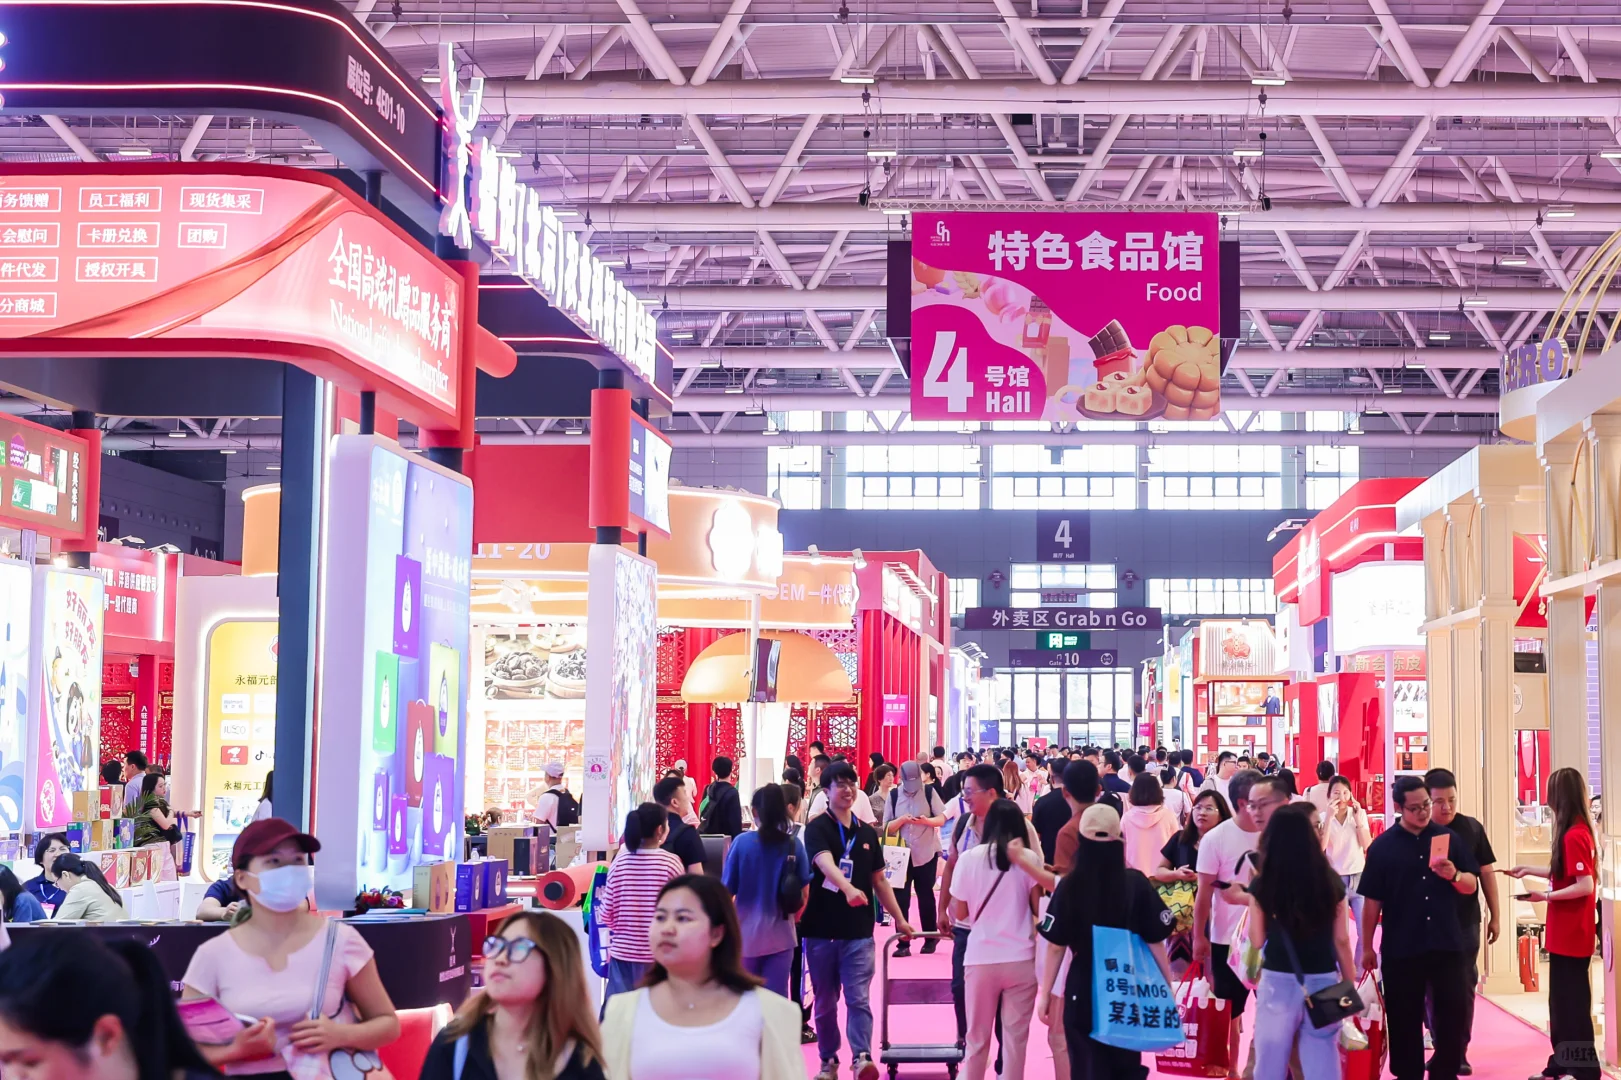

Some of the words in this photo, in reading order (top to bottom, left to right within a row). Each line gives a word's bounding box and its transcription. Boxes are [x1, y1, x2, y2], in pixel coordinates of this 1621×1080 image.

[0, 194, 49, 208] 务馈赠
[89, 193, 149, 208] 员工福利
[189, 192, 251, 209] 现货集采
[0, 229, 48, 243] 会慰问
[87, 228, 148, 243] 卡册兑换
[187, 229, 218, 244] 团购
[987, 230, 1204, 271] 特色食品馆
[85, 262, 145, 278] 授权开具
[328, 228, 451, 358] 全国高端礼赠品服务商
[1146, 282, 1202, 301] Food
[330, 298, 373, 344] National
[923, 331, 973, 412] 4
[985, 365, 1029, 387] 号馆
[986, 391, 1030, 413] Hall
[1055, 520, 1072, 548] 4
[992, 610, 1050, 627] 外卖区
[1055, 611, 1101, 626] Grab
[1106, 614, 1116, 626] n
[1122, 611, 1147, 626] Go
[1064, 652, 1079, 666] 10
[1108, 1001, 1181, 1028] 某某送的
